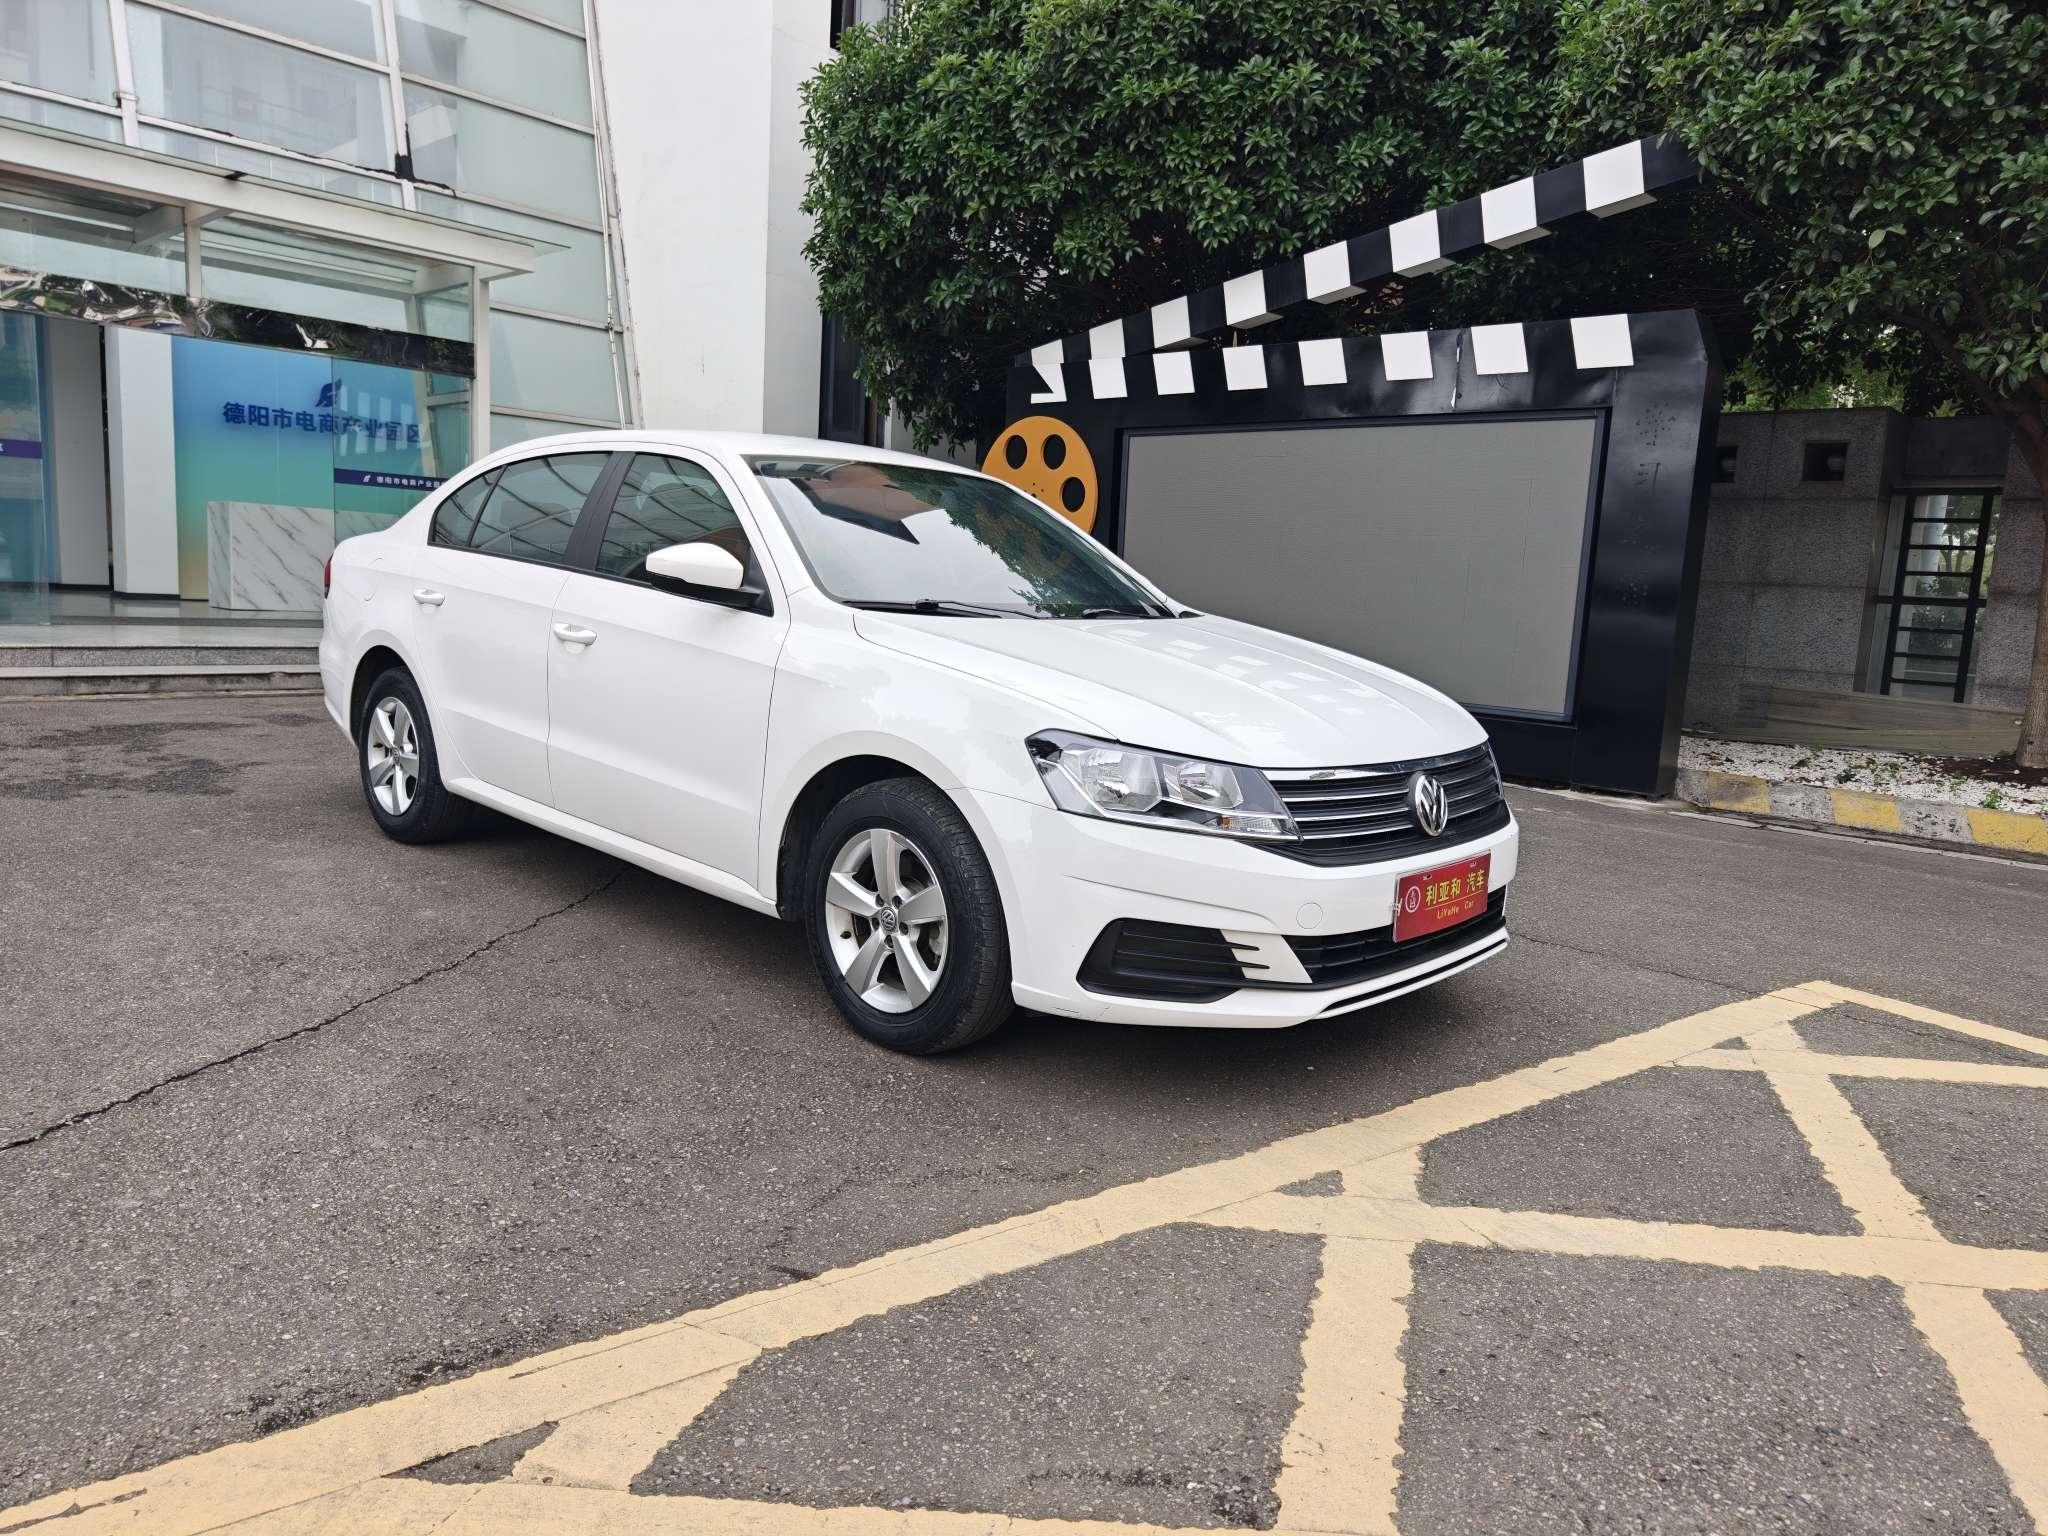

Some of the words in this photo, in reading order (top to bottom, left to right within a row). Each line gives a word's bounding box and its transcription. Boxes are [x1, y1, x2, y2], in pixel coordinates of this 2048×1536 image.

[222, 402, 420, 443] 德阳市电商产业园区
[1425, 878, 1461, 906] 利亚和
[1466, 869, 1485, 893] 汽车
[1464, 901, 1474, 909] Car
